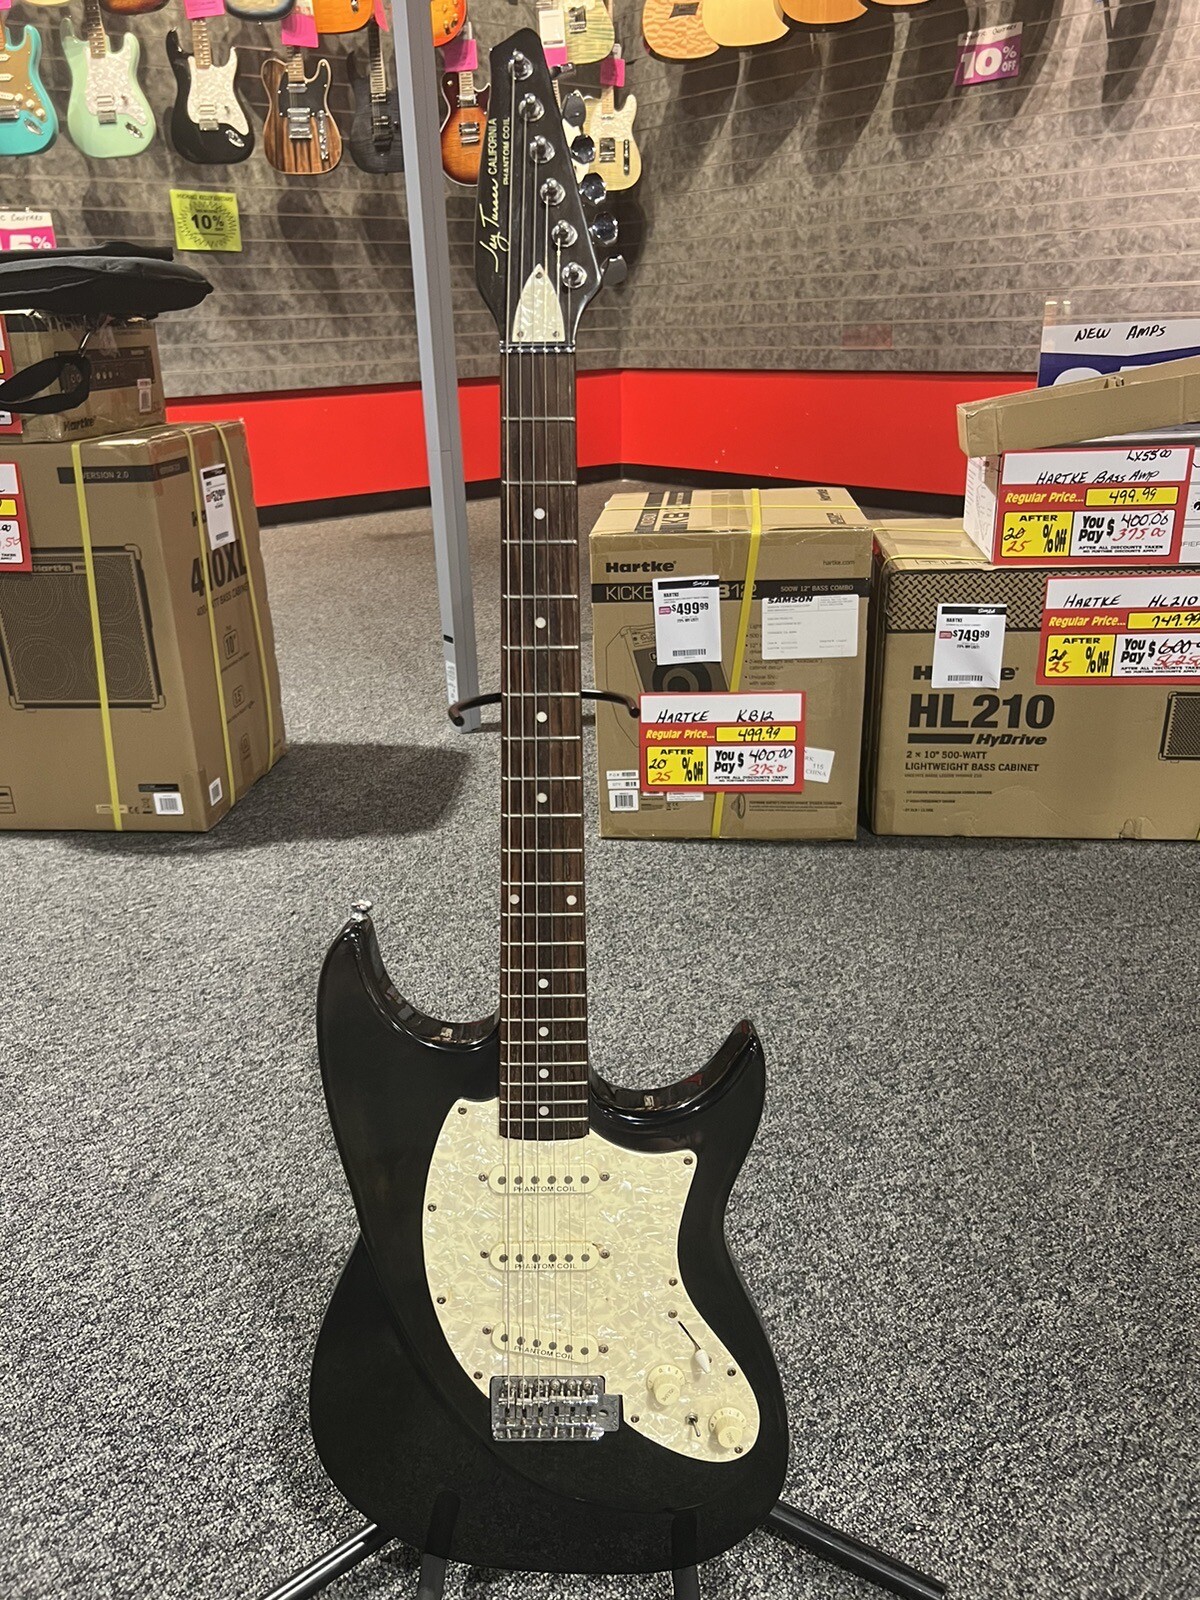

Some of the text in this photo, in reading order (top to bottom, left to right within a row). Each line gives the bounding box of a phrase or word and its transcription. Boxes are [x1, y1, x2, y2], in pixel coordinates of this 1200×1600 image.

[1001, 60, 1017, 72] OFF
[487, 118, 498, 176] CALIFORNIA
[502, 117, 511, 186] PHANTOM COIL
[1074, 327, 1111, 342] NEW
[64, 416, 96, 431] Hartke
[116, 471, 129, 479] 2.0
[1036, 471, 1089, 485] HARTKE
[1005, 492, 1047, 505] Regular
[1109, 487, 1157, 504] 499.99
[1078, 529, 1105, 544] Pay
[1006, 540, 1032, 553] 25
[605, 561, 675, 573] Hartke
[1063, 593, 1198, 608] HARTKE HL210
[1048, 616, 1089, 628] Regular
[1120, 651, 1146, 665] Pay
[1048, 661, 1072, 673] 25
[656, 709, 775, 723] HARTKE KB12
[908, 693, 1055, 729] HL210
[646, 729, 681, 740] Regular
[738, 726, 781, 741] 499.99
[975, 734, 1047, 747] HyDrive
[906, 751, 913, 759] 2
[941, 751, 987, 760] 500-WATT
[649, 759, 667, 769] 20
[714, 762, 736, 774] Pay
[905, 763, 969, 771] LIGHTWEIGHT
[972, 763, 995, 771] BASS
[651, 771, 673, 782] 25
[513, 1345, 574, 1360] PHANTOM COIL
